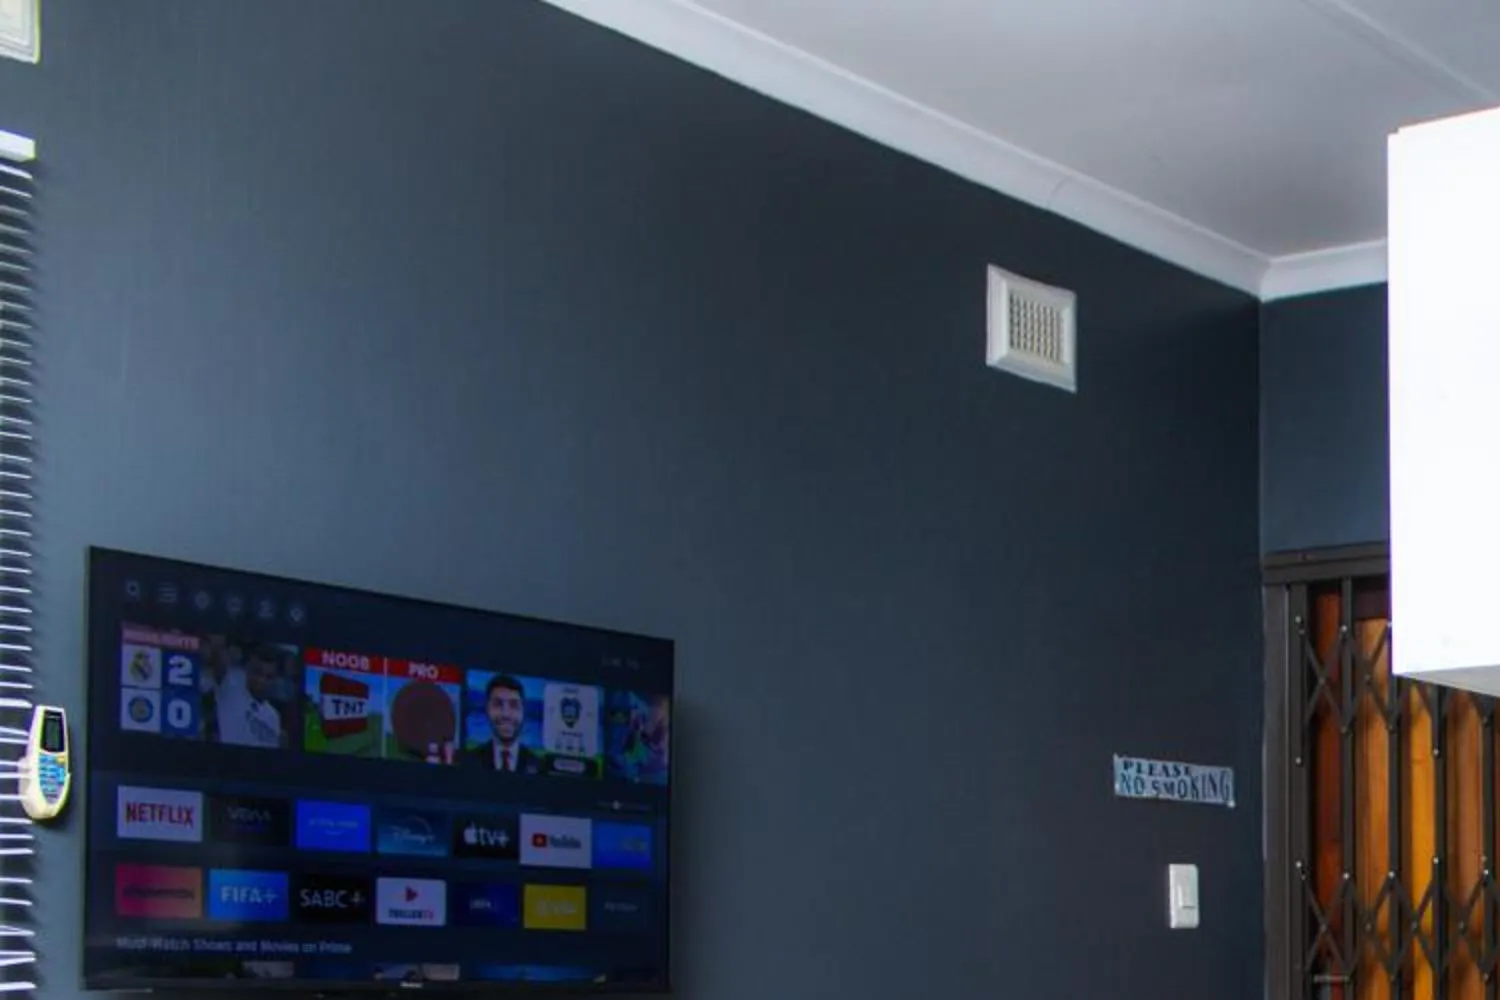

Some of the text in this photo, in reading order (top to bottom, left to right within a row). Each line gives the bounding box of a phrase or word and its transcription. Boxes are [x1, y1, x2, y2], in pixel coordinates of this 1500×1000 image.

[168, 655, 193, 686] 2
[321, 649, 369, 671] NOOB
[408, 661, 439, 679] PRO
[167, 698, 192, 729] 0
[332, 699, 366, 716] TNT
[1122, 760, 1192, 778] PLEASE
[1120, 770, 1231, 801] NO SMOKING
[126, 802, 194, 828] NETFLIX
[479, 826, 509, 848] tv+
[221, 885, 280, 904] FIFA+
